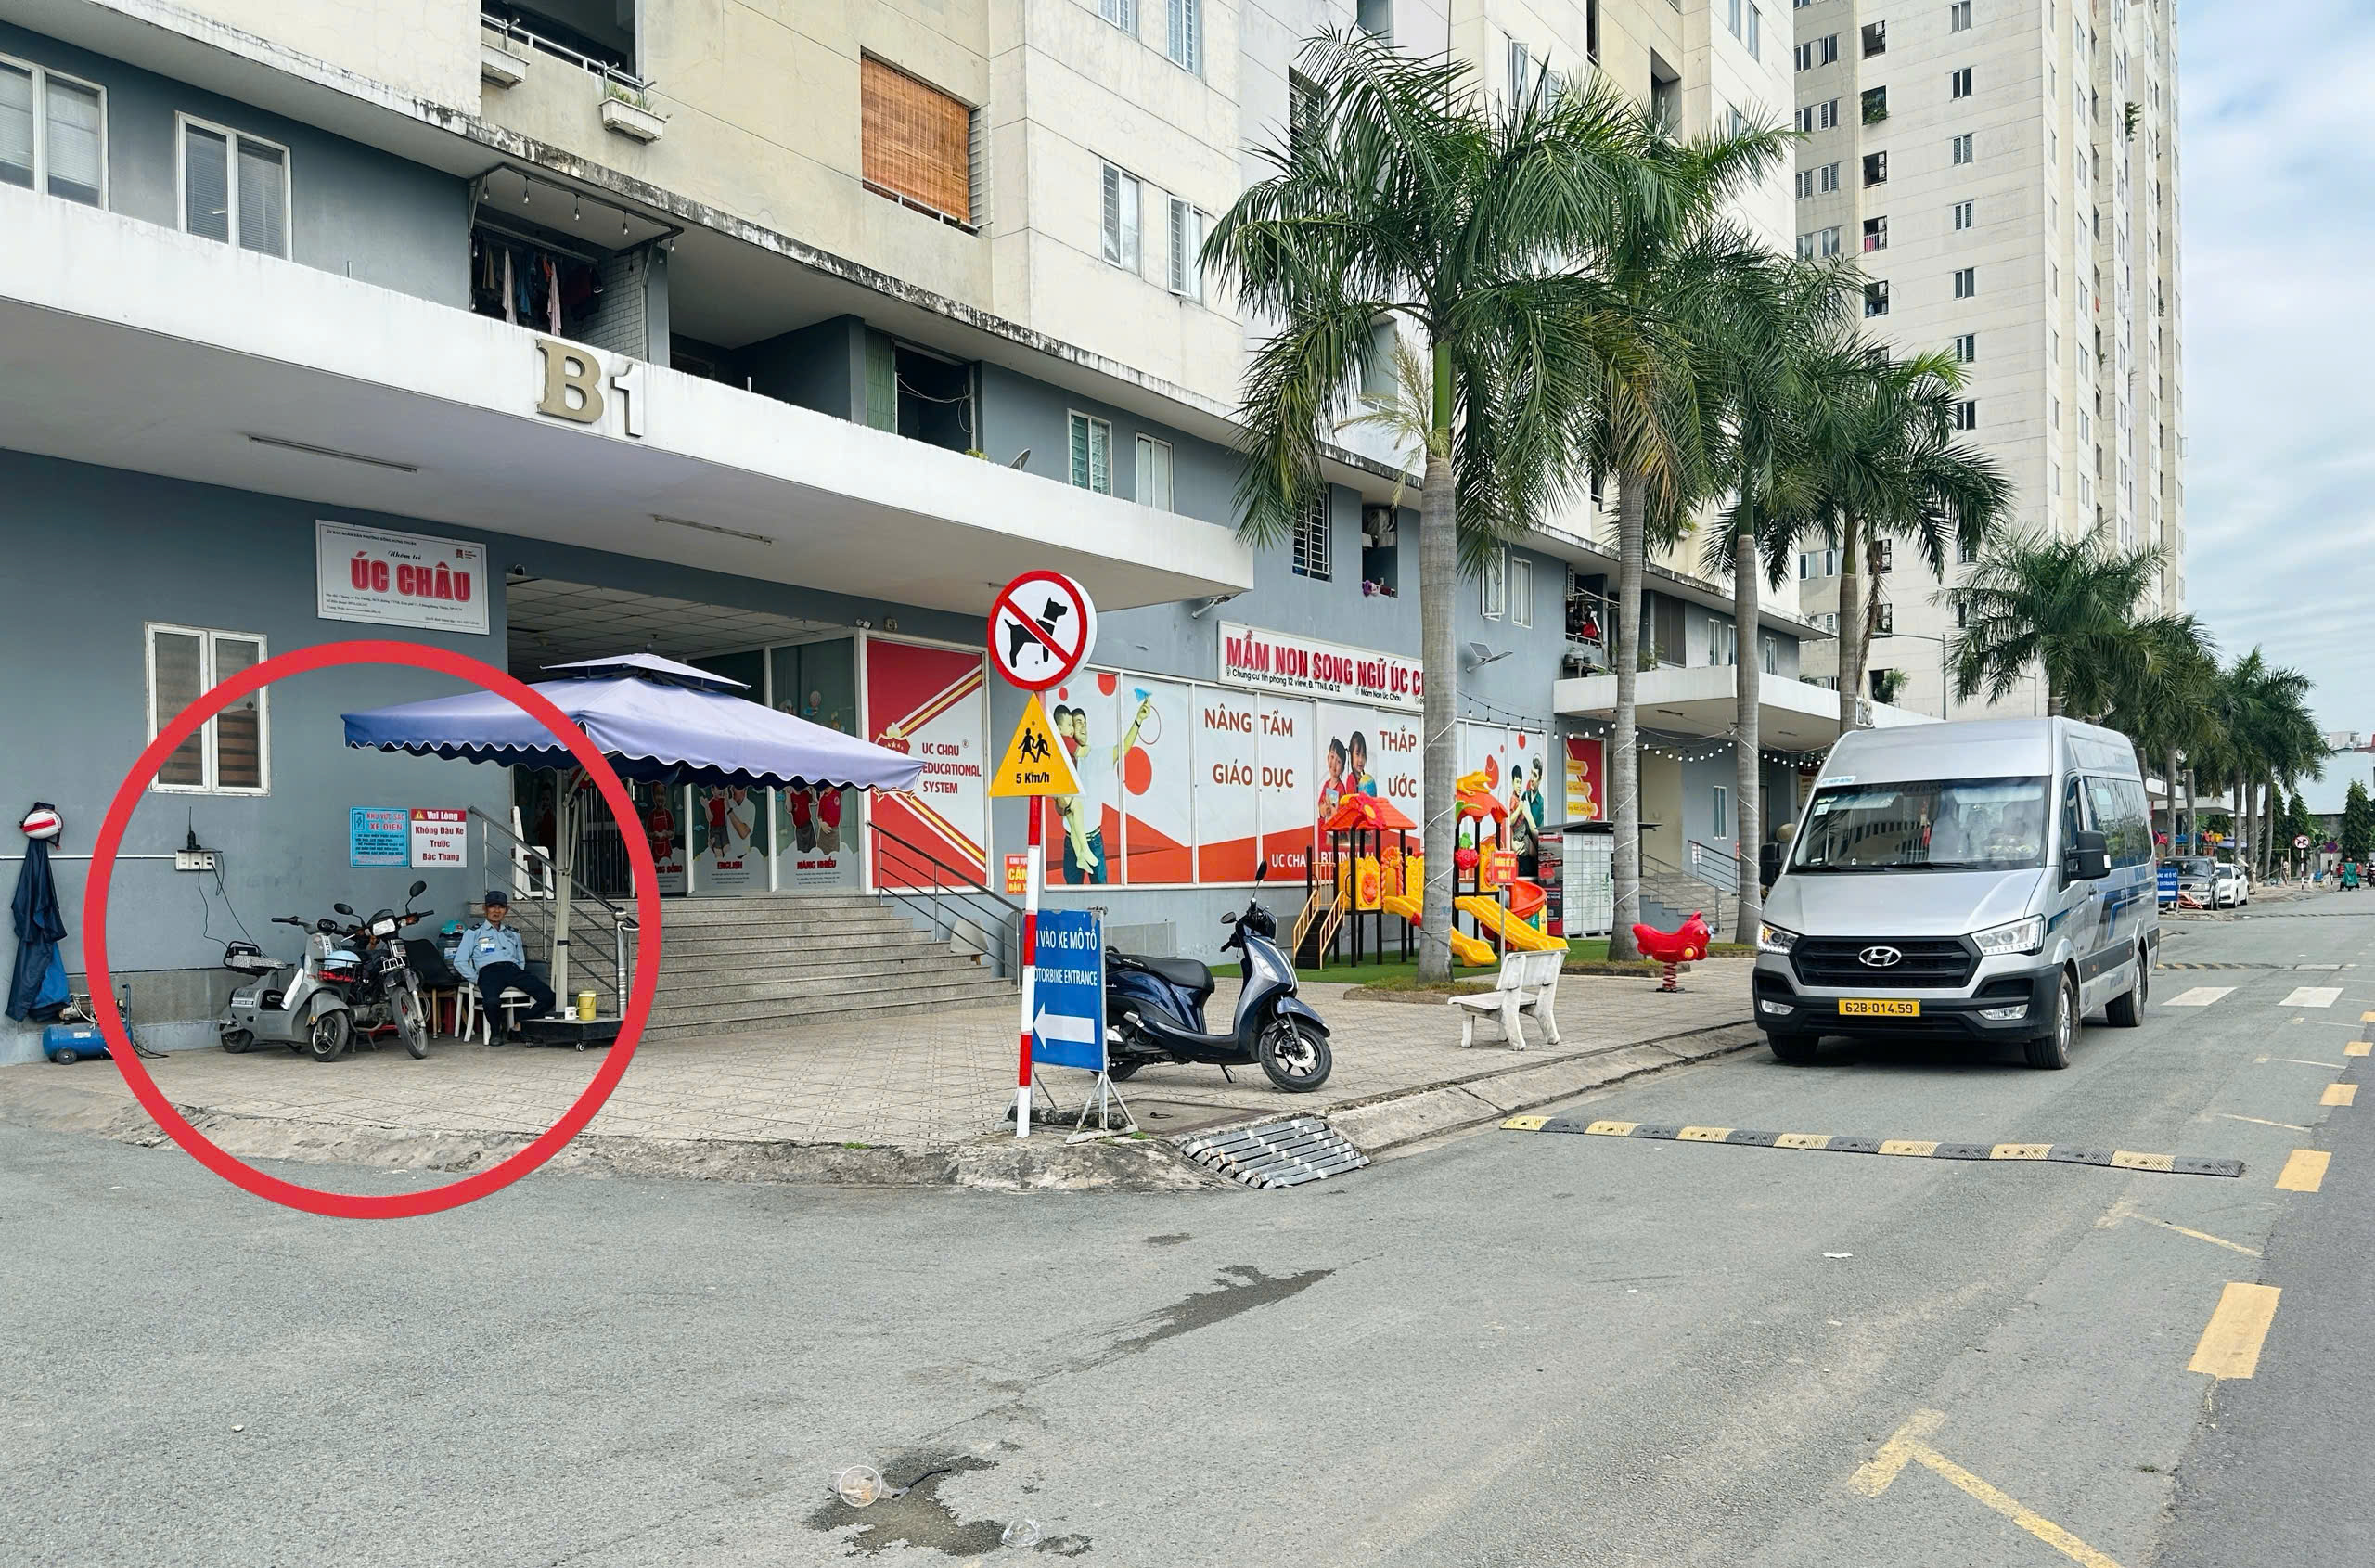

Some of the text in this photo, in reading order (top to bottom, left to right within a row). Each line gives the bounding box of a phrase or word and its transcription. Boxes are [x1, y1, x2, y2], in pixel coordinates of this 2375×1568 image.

[350, 550, 390, 594] ÚC
[396, 561, 471, 603] CHÂU
[1225, 629, 1270, 673] MẦM
[1274, 645, 1308, 678] NON
[1312, 652, 1354, 686] SONG
[1356, 657, 1387, 690] NGỮ
[1389, 660, 1408, 693] ÚC
[1232, 668, 1252, 681] Chung
[1287, 676, 1293, 686] 12
[1204, 703, 1293, 738] NÂNG TẦM
[922, 742, 959, 756] UC CHAU
[922, 762, 982, 777] EDUCATIONAL
[1213, 758, 1294, 793] GIÁO DỤC
[1016, 771, 1050, 784] 5 Km/h
[1388, 772, 1417, 798] ƯỚC
[922, 780, 958, 794] SYSTEM
[426, 811, 439, 820] Vui
[415, 826, 439, 836] Không
[438, 853, 460, 862] Thang
[1271, 854, 1307, 868] UC CHA
[1039, 925, 1057, 949] VÀO
[1058, 930, 1069, 949] XE
[1069, 926, 1085, 950] MÔ
[1085, 927, 1098, 951] TÔ
[1034, 967, 1098, 986] OTORBIKE ENTRANCE
[1845, 1002, 1913, 1014] 62B-014.59
